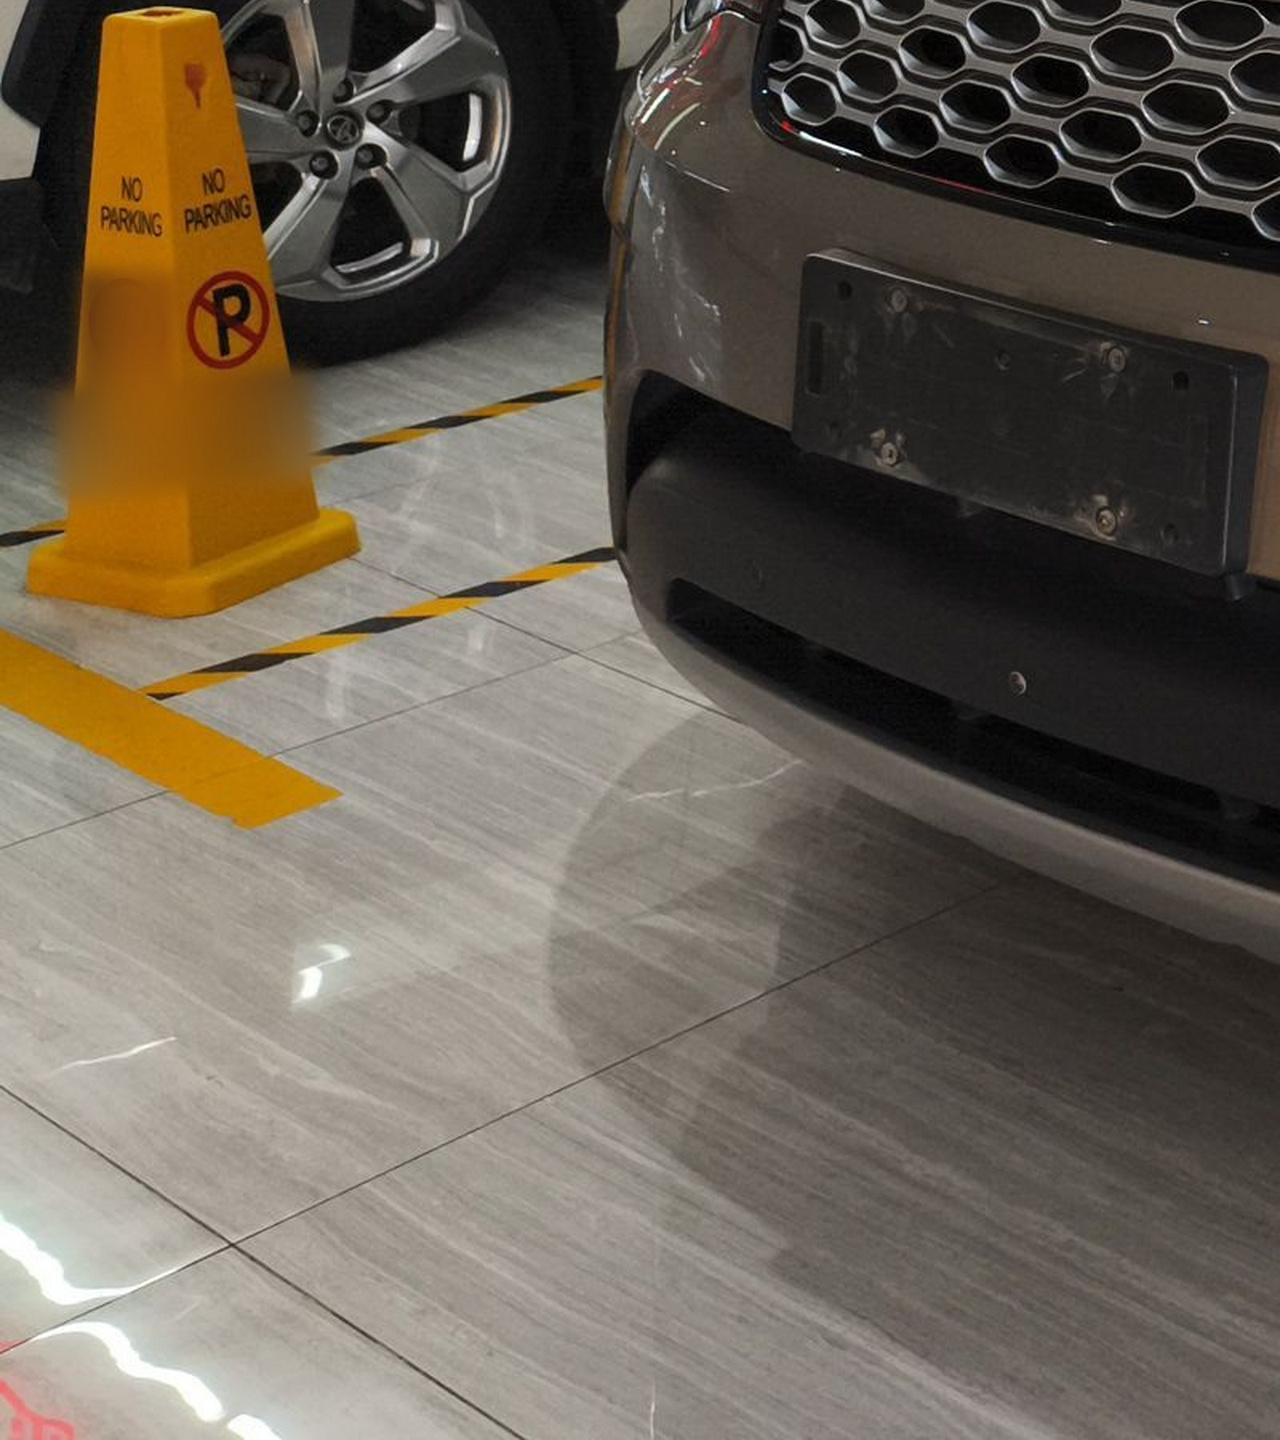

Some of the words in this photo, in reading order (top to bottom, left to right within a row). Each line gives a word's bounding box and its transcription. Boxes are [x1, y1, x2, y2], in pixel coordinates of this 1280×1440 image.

[121, 176, 143, 202] NO
[202, 168, 226, 195] NO
[100, 205, 163, 237] PARKING
[184, 194, 252, 233] PARKING
[212, 283, 251, 357] P
